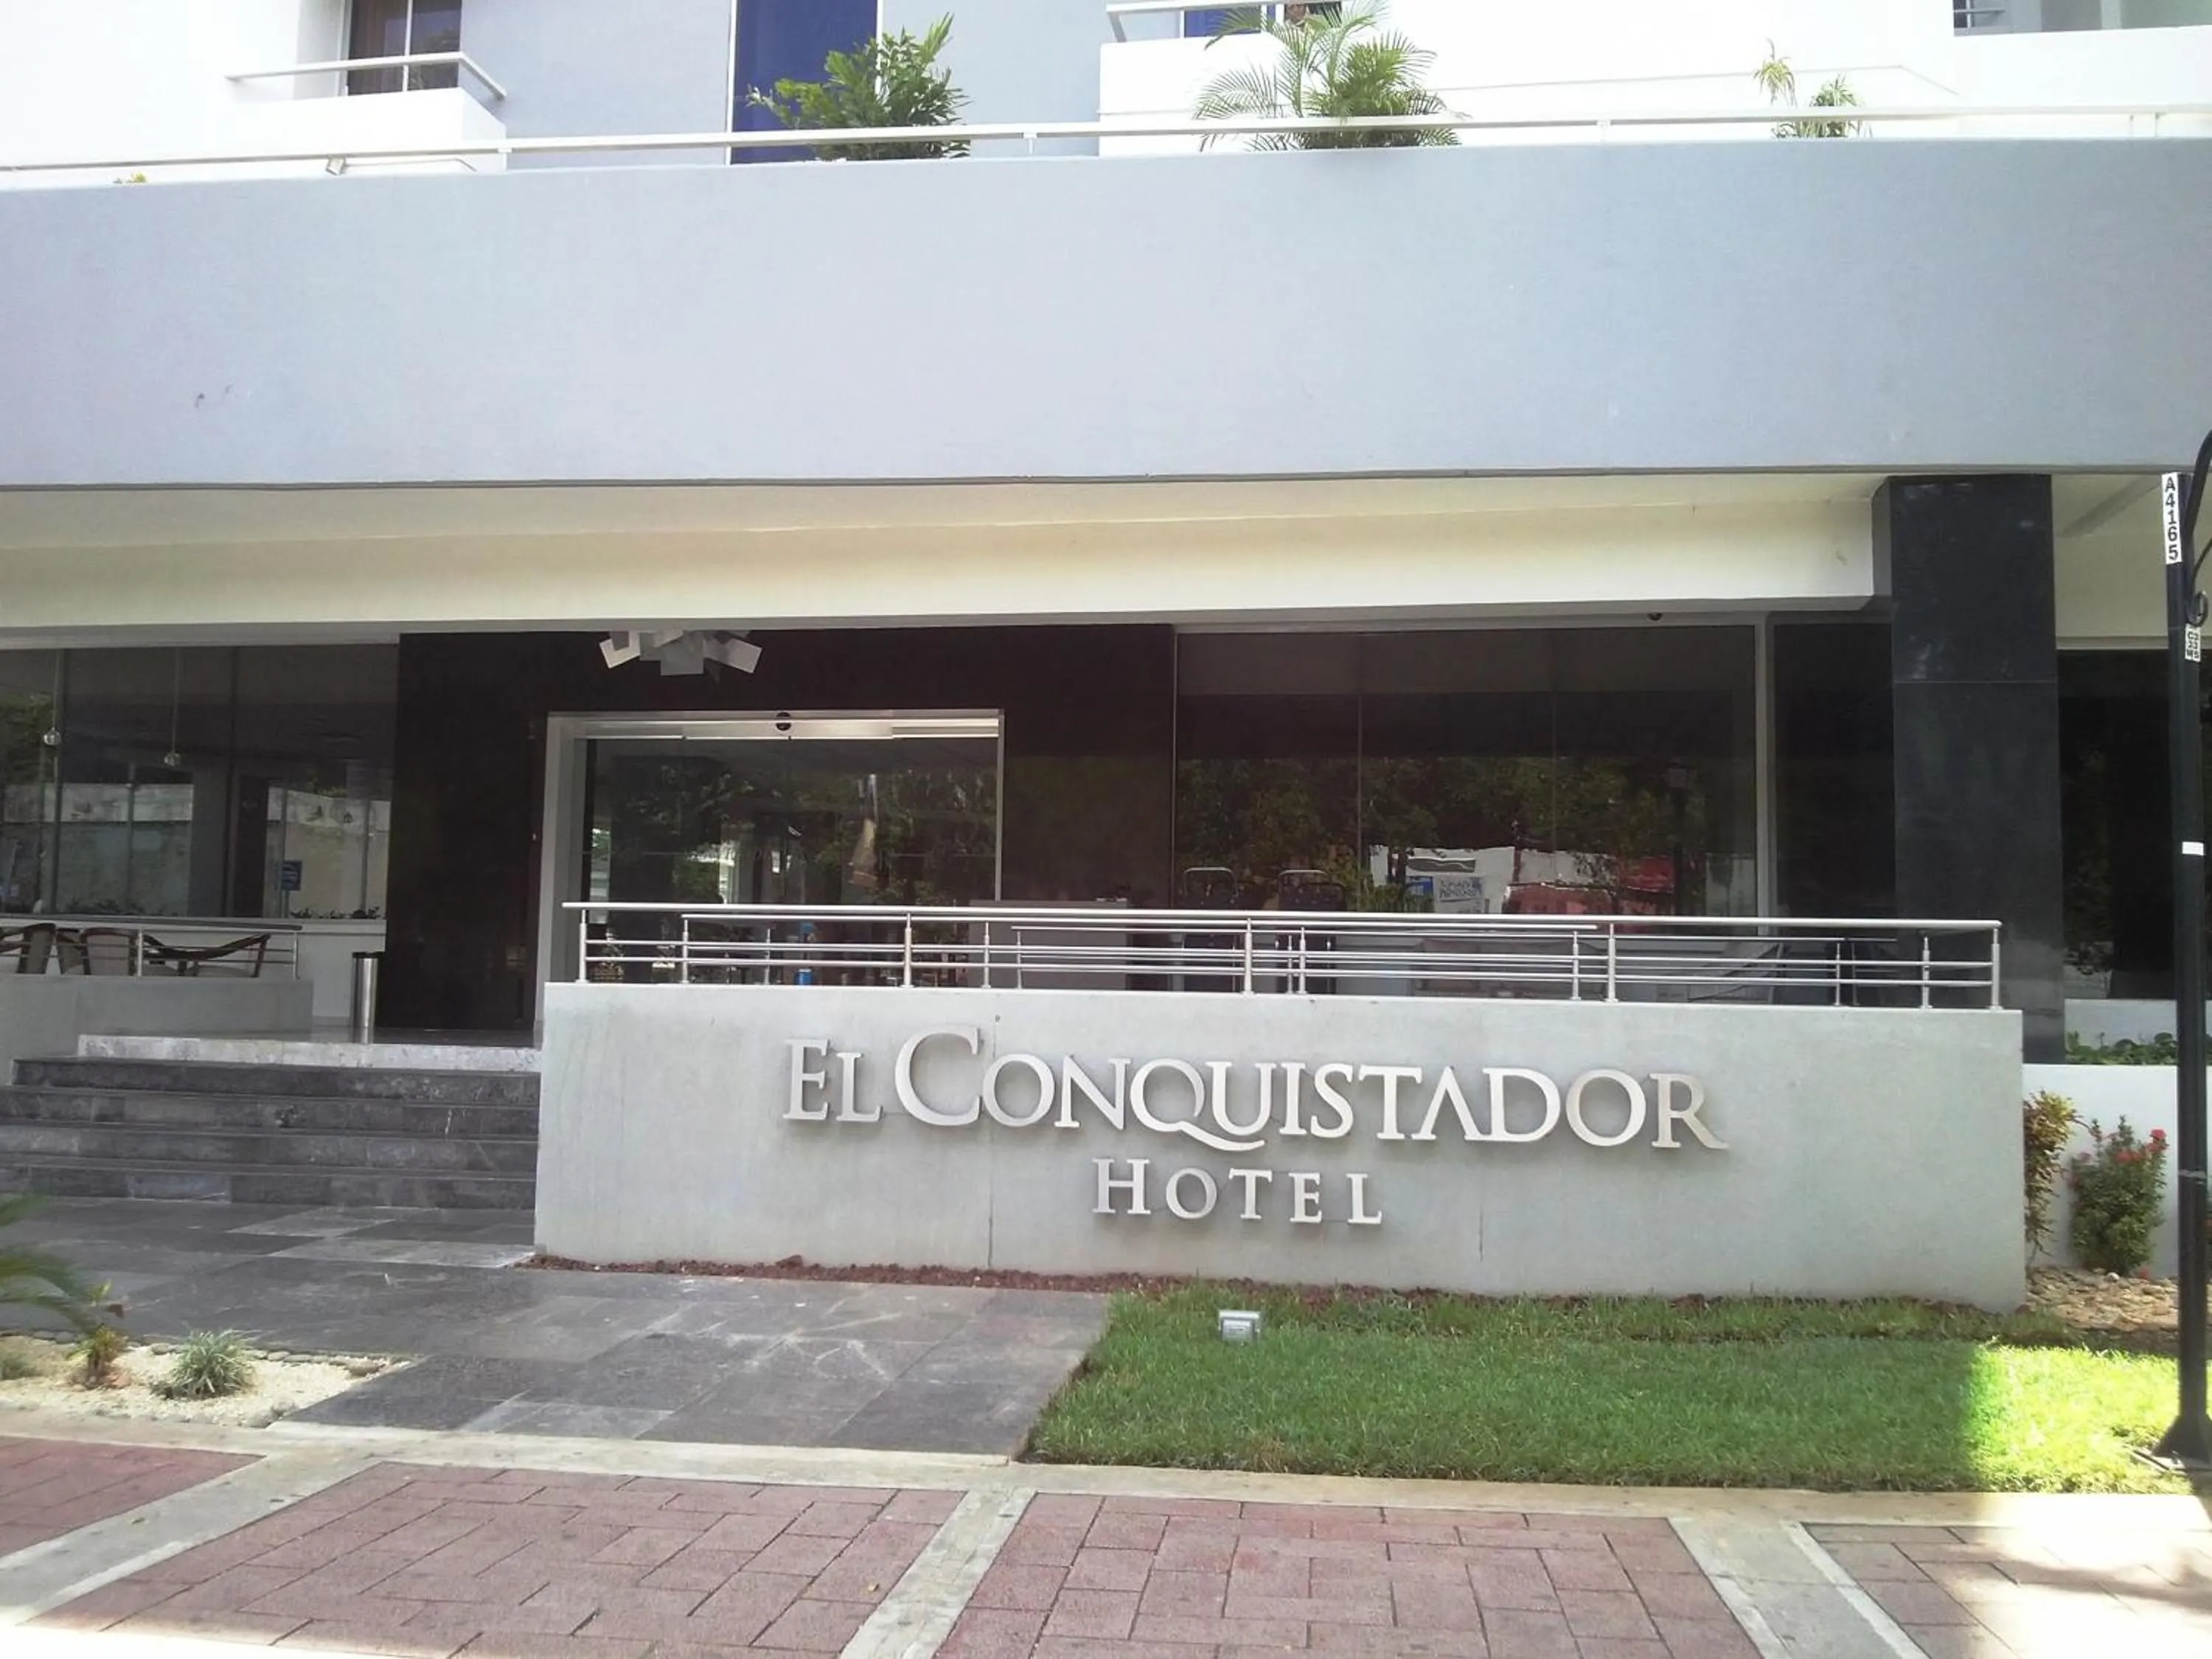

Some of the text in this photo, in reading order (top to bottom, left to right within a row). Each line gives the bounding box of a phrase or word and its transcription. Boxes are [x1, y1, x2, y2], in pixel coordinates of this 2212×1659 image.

[2165, 476, 2179, 560] A4165
[783, 1028, 1729, 1151] EL CONQUISTADOR
[1092, 1158, 1382, 1225] HOTEL
